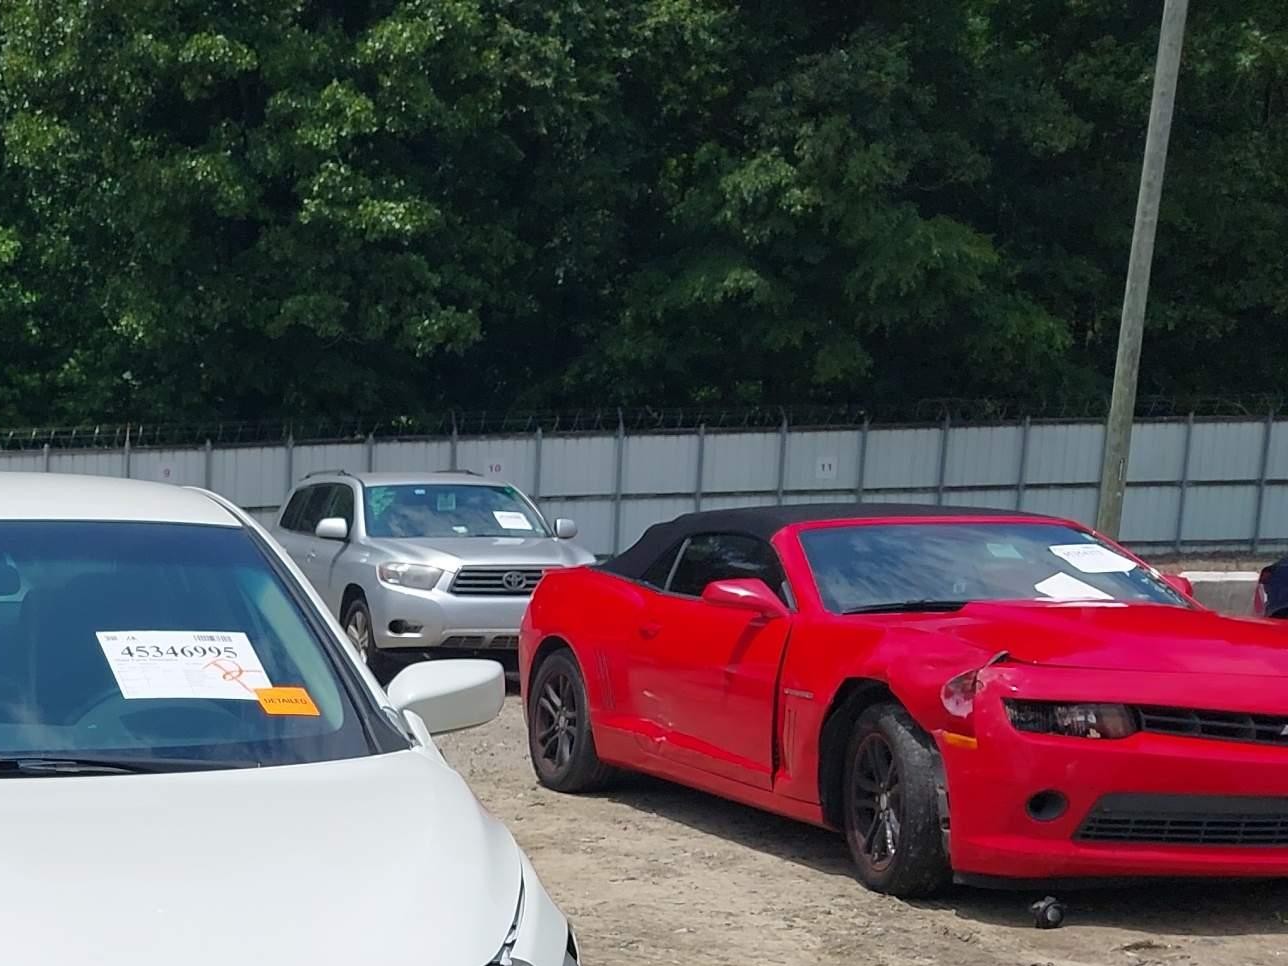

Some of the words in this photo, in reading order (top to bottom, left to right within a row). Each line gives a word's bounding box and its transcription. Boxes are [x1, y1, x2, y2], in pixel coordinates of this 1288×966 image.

[489, 464, 501, 473] 10
[822, 463, 832, 472] 11
[120, 645, 238, 659] 45346995
